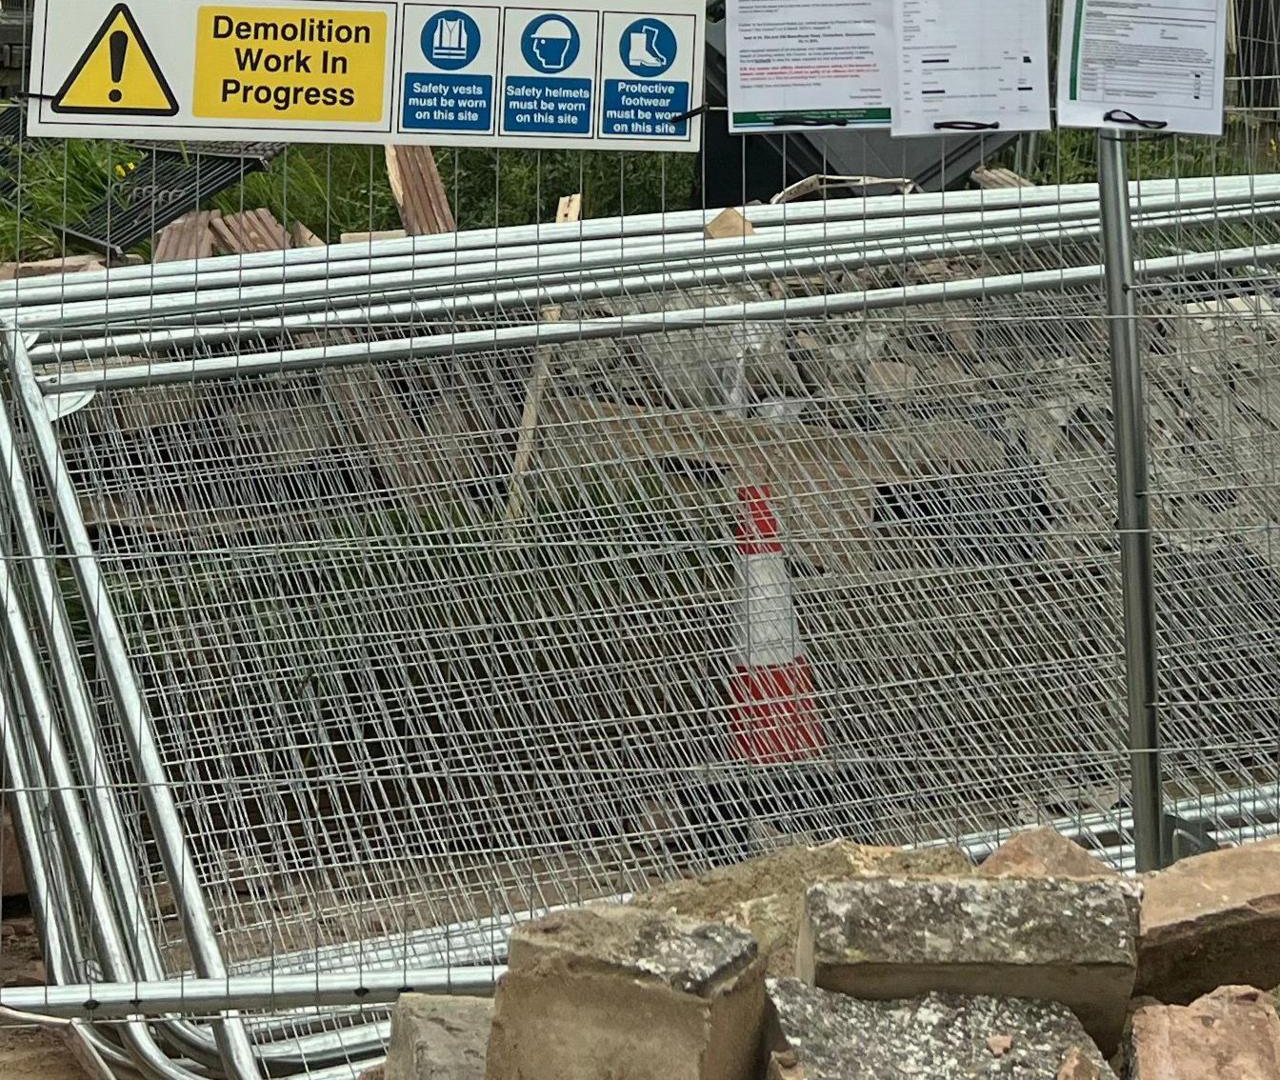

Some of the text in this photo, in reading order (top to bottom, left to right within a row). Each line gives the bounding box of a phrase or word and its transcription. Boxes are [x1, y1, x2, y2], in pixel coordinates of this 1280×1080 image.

[212, 15, 371, 43] Demolition
[234, 47, 348, 74] Work In
[221, 78, 355, 111] Progress
[412, 82, 483, 96] Safety vests
[506, 85, 590, 99] Safety helmets
[618, 81, 675, 95] Protective
[408, 96, 487, 109] must be worn
[508, 99, 586, 112] must be worn
[621, 95, 671, 108] footwear
[415, 109, 479, 122] on this site
[516, 112, 578, 125] on this site
[606, 108, 635, 119] must
[637, 109, 652, 120] be
[613, 122, 676, 134] on this site
